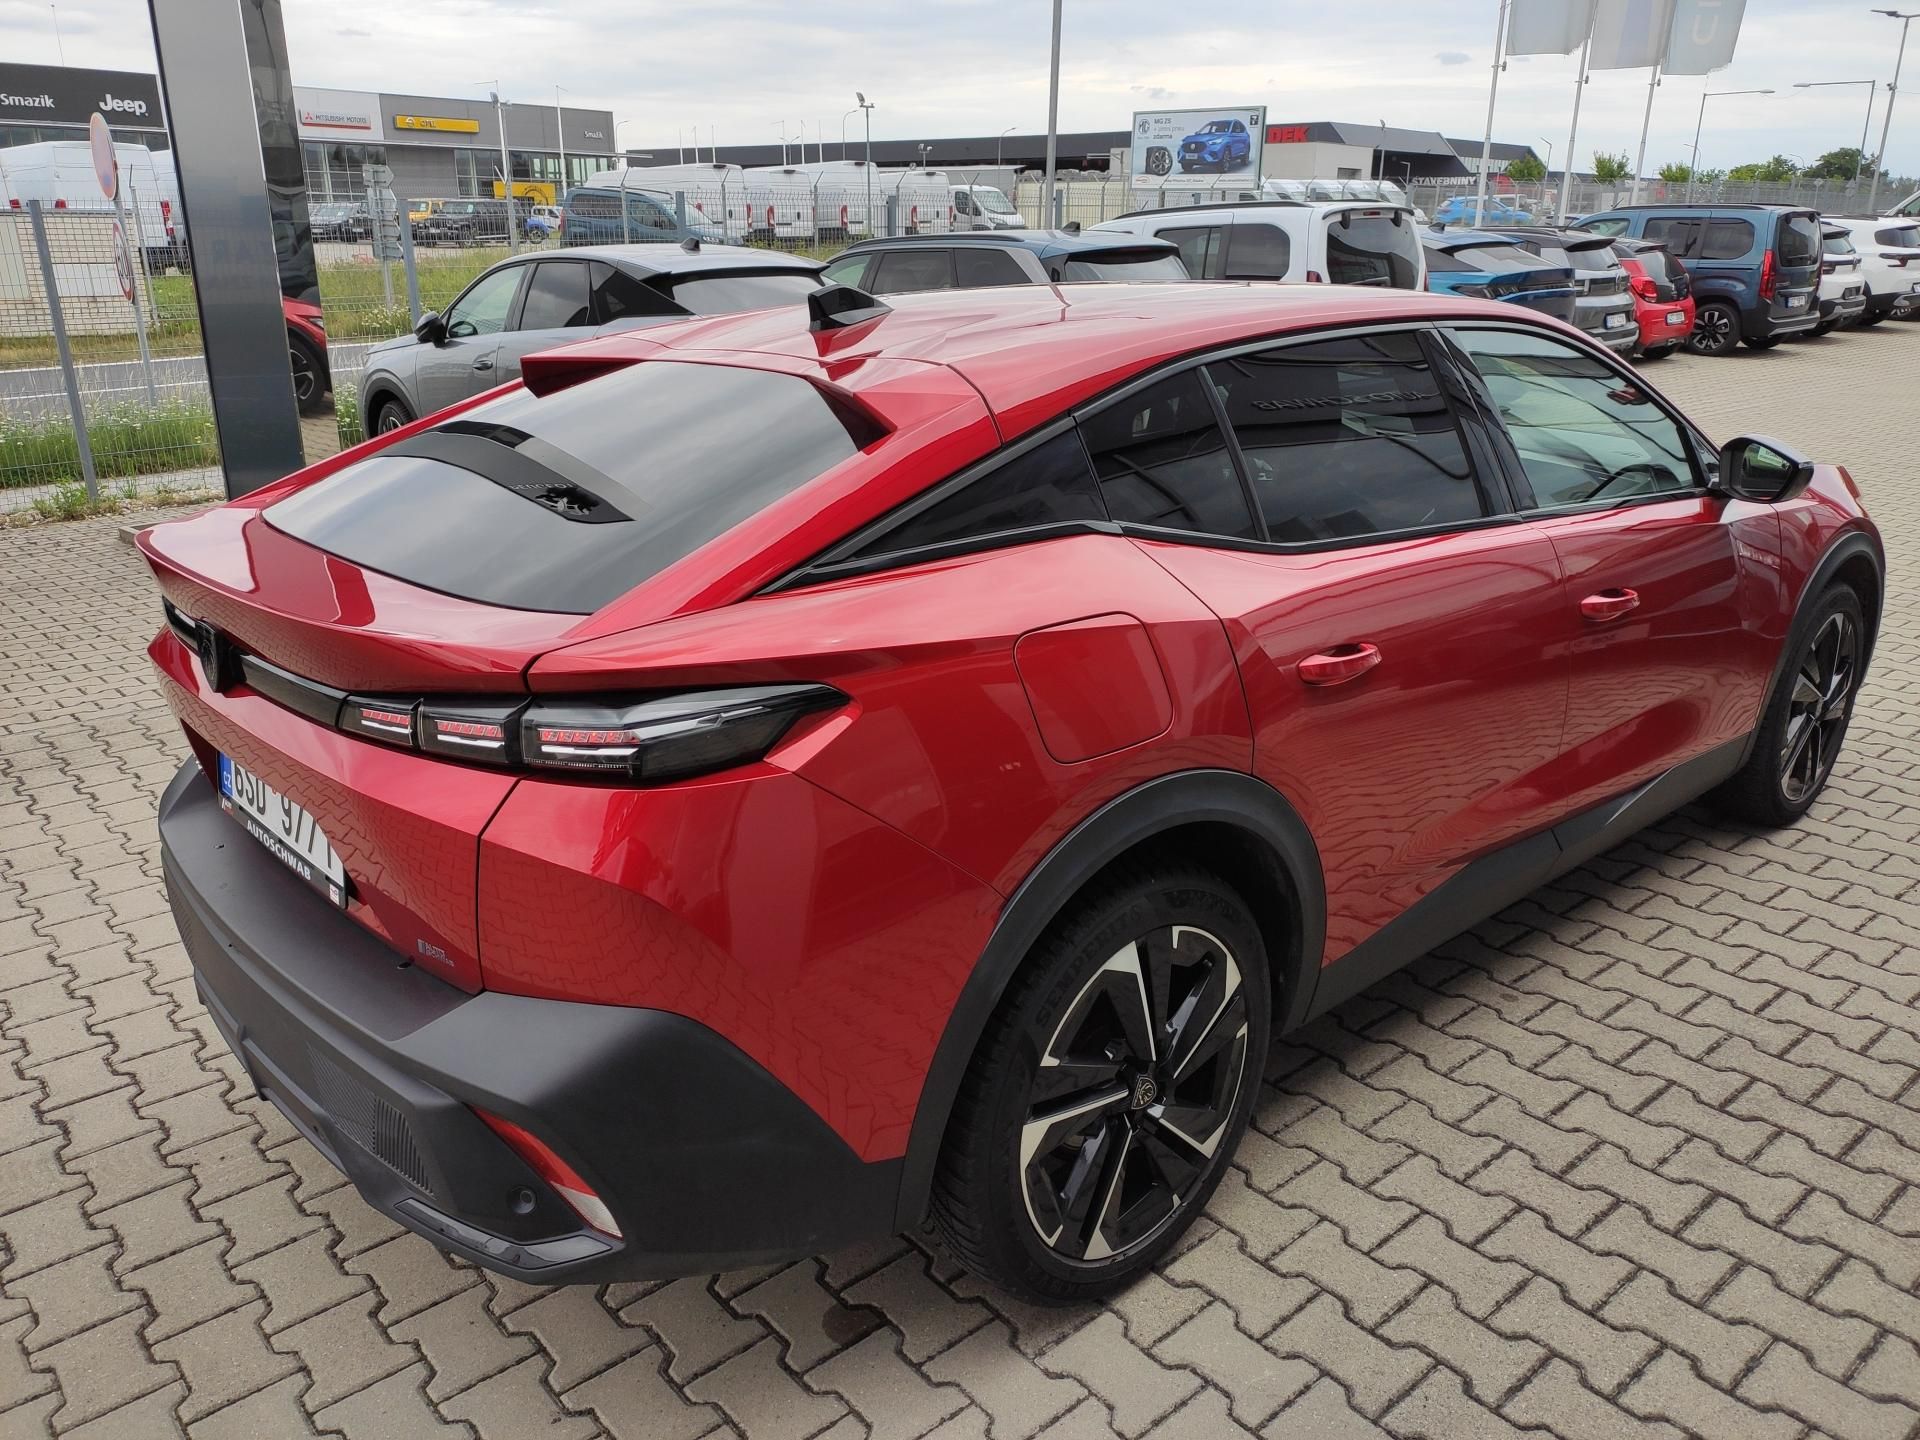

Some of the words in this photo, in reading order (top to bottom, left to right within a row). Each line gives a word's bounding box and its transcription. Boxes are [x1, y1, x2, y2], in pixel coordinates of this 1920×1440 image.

[0, 93, 55, 108] Smazik
[99, 94, 147, 116] Jeep
[315, 114, 345, 122] MITSUBISHI
[346, 116, 367, 124] MOTORS
[1267, 127, 1309, 144] DEK
[1412, 176, 1477, 186] STAVEBNINY
[223, 771, 232, 788] CZ
[247, 819, 311, 881] AUTOSCHWAB
